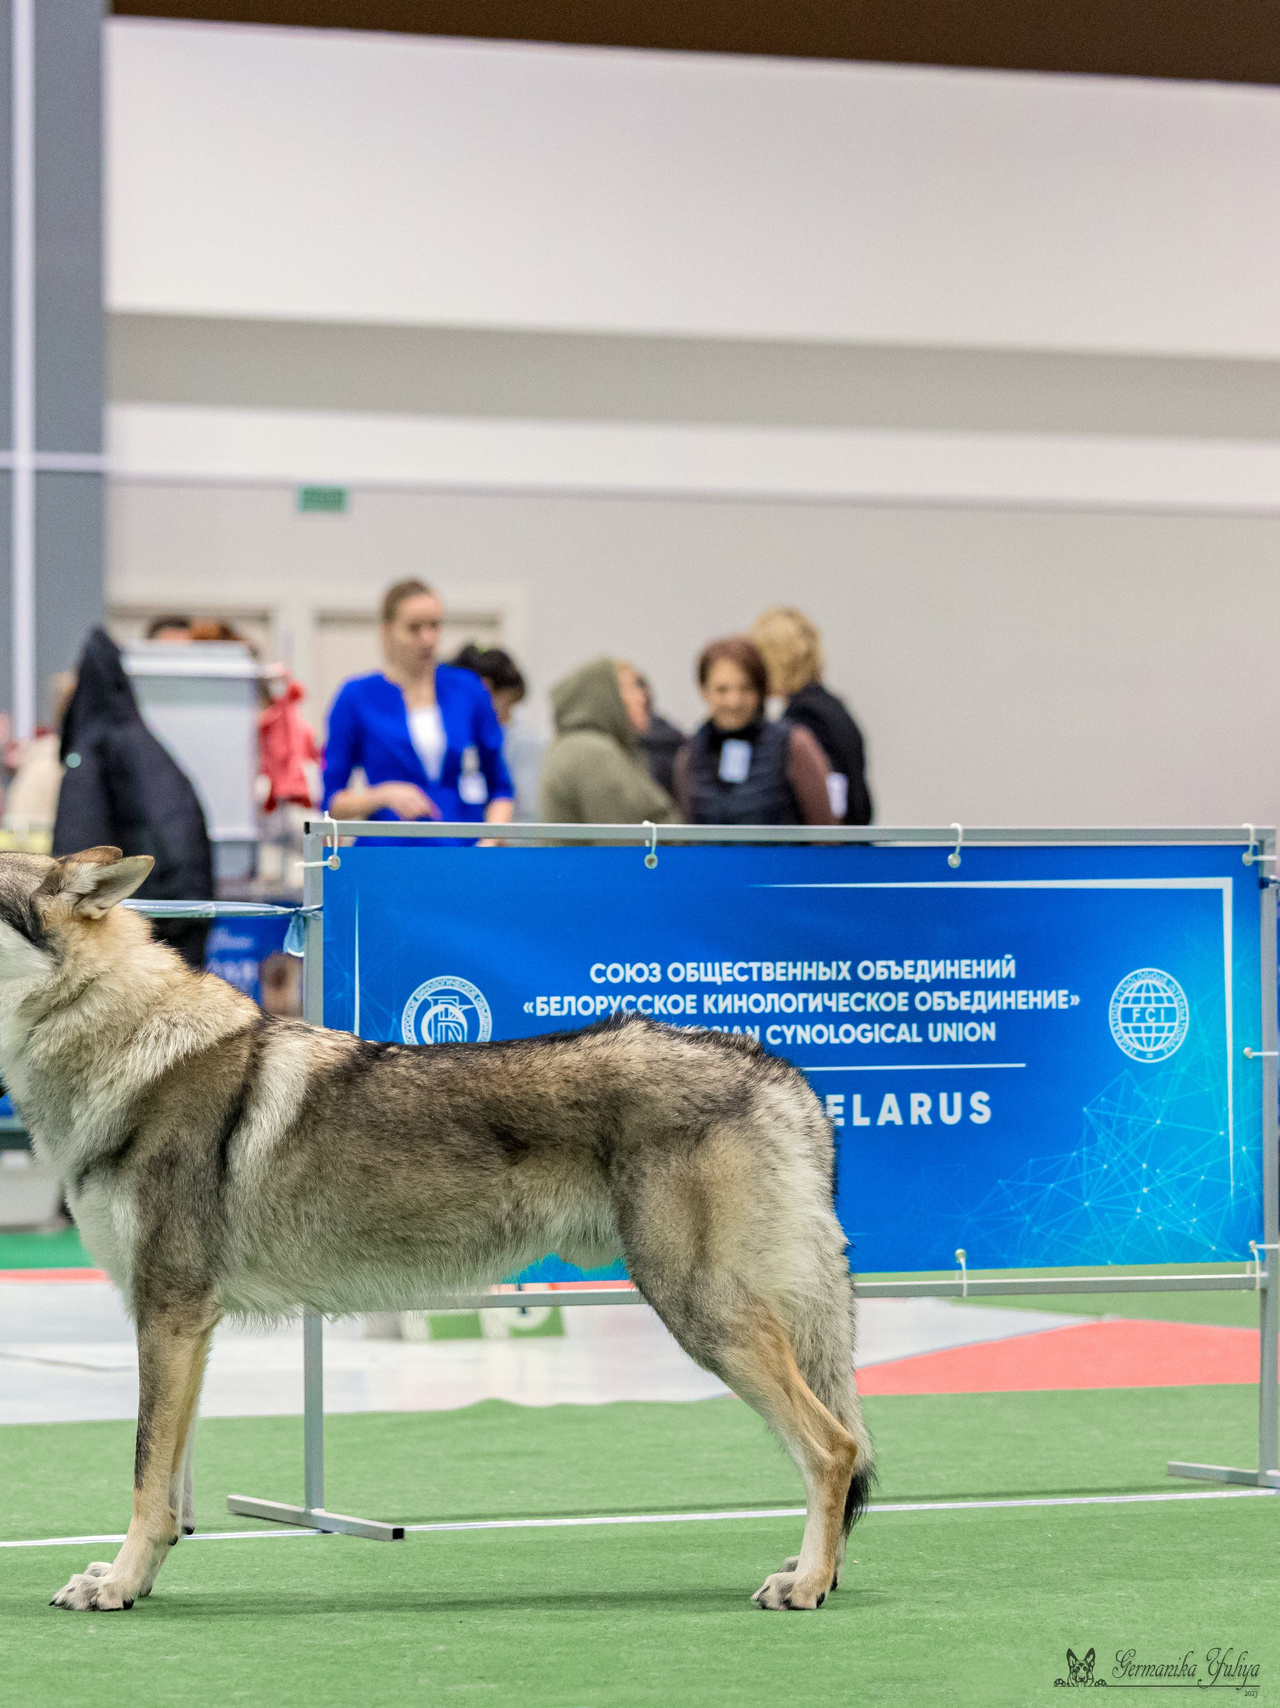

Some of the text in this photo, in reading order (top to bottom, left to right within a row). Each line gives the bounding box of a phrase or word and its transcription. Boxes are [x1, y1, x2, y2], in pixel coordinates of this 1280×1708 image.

[589, 954, 1017, 985] СОЮЗ ОБЩЕСТВЕННЫХ ОБЪЕДИНЕНИЙ
[523, 989, 1081, 1017] «БЕЛОРУССКОЕ КИНОЛОГИЧЕСКОЕ ОБЪЕДИНЕНИЕ»
[1132, 1007, 1165, 1023] FCI
[765, 1023, 923, 1045] CYNOLOGICAL
[927, 1021, 997, 1043] UNION
[825, 1090, 992, 1127] ELARUS
